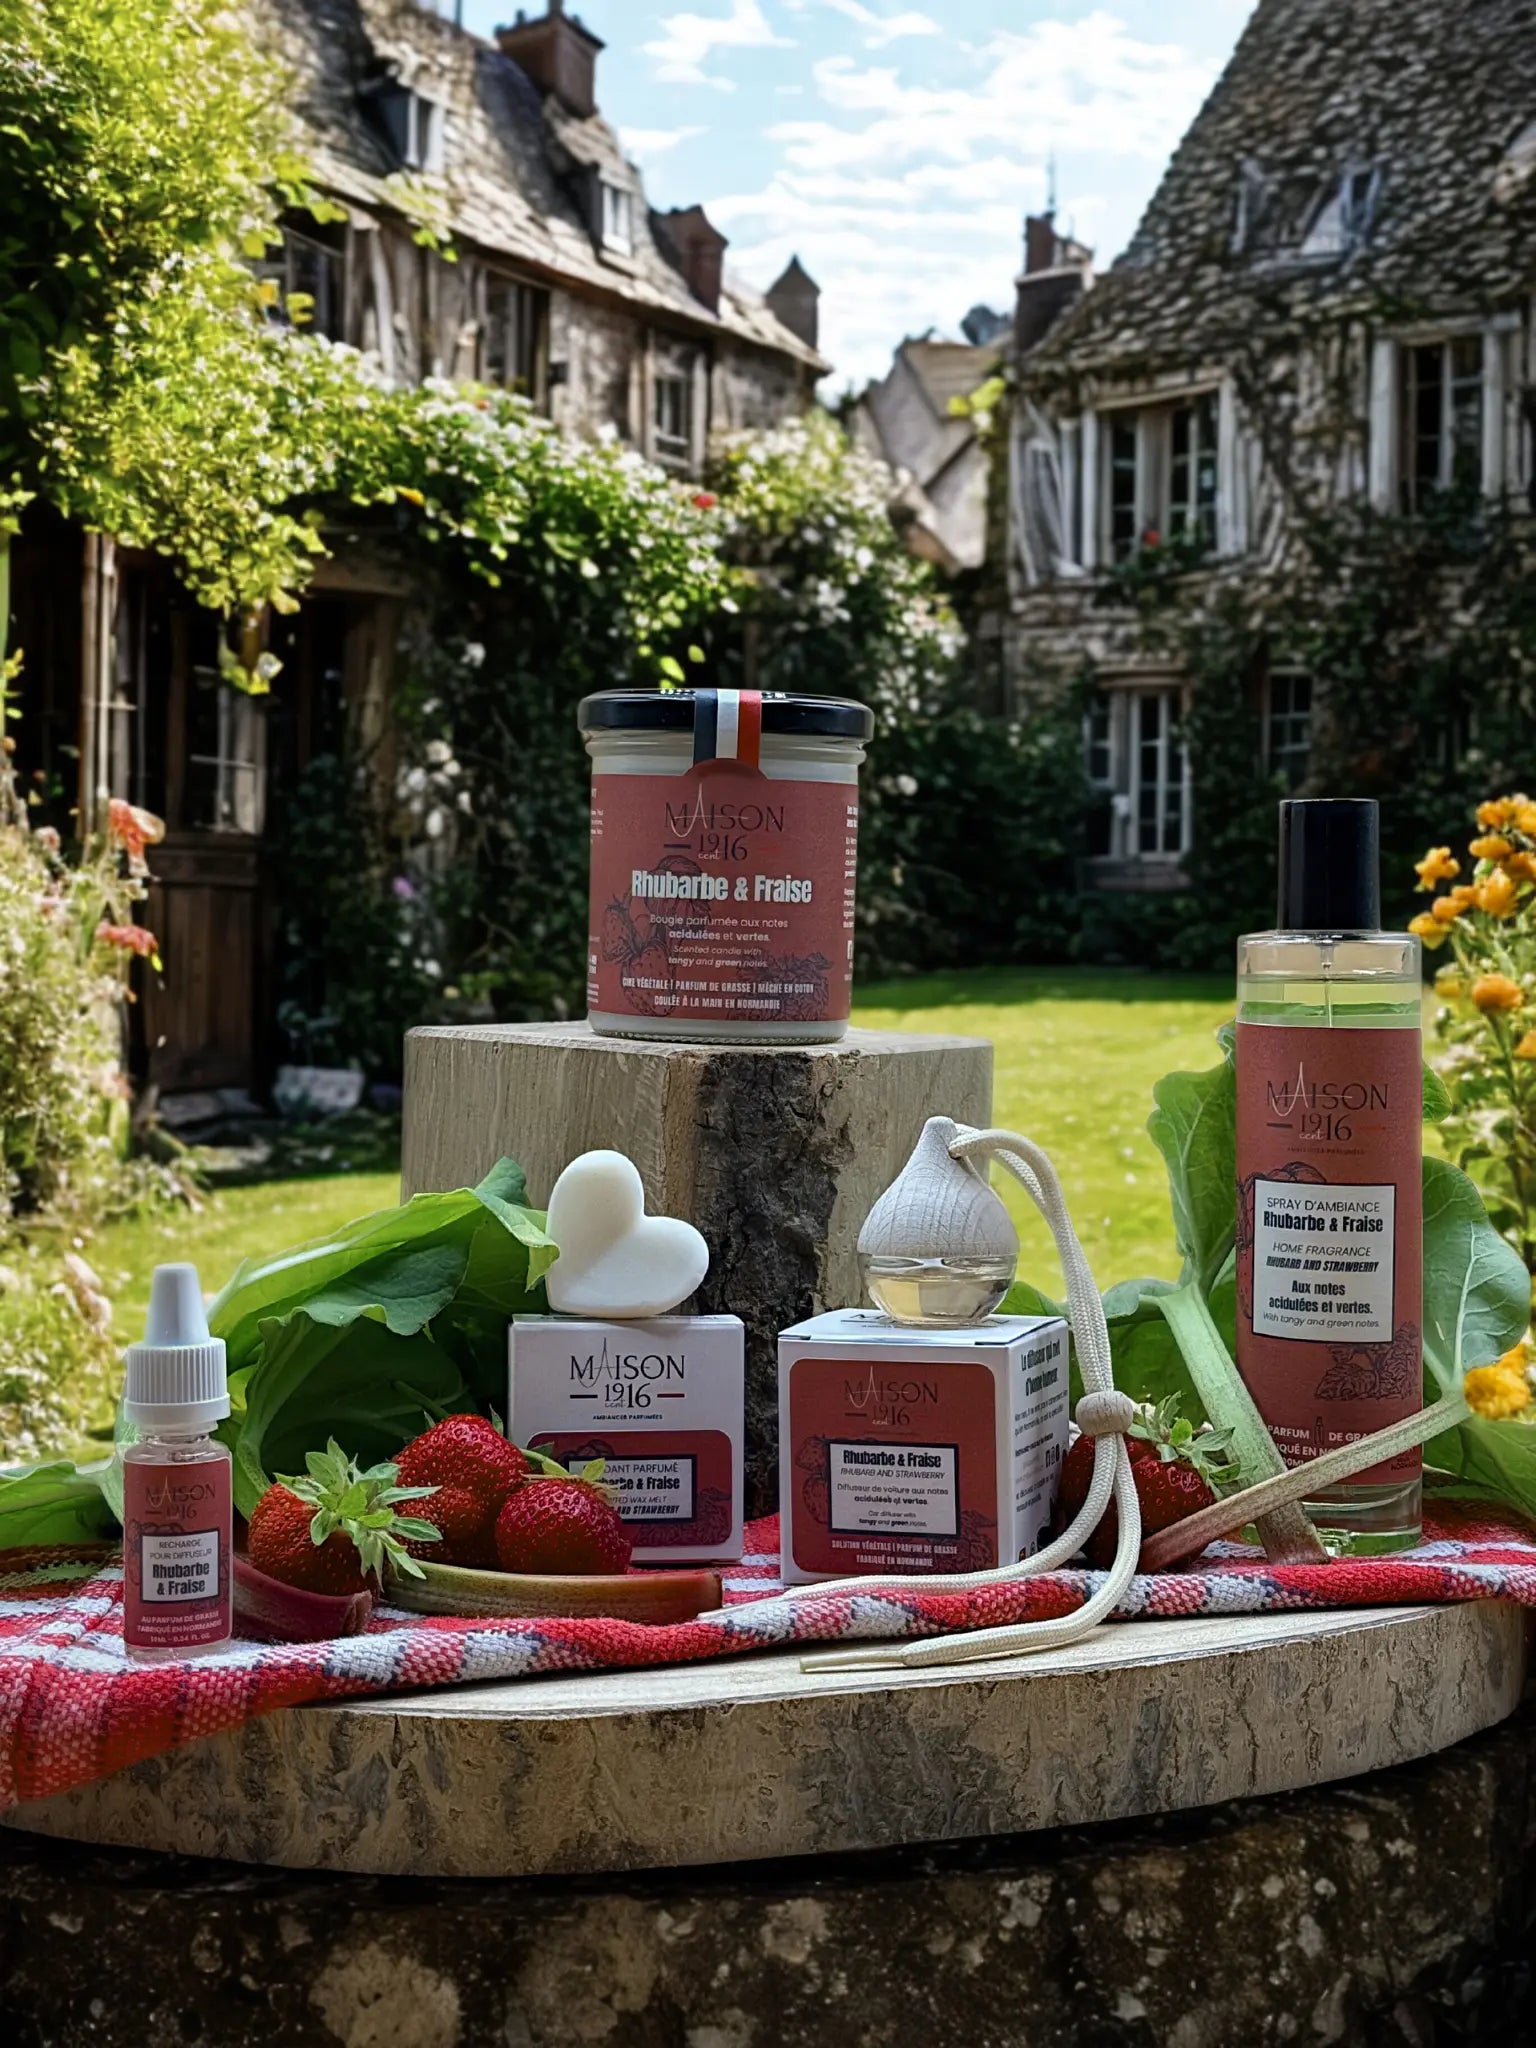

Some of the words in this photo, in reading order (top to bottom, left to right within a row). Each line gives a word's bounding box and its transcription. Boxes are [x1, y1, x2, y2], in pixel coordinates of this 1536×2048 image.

[664, 783, 784, 838] MAISON
[699, 833, 748, 861] 1916
[632, 870, 728, 901] Rhubarbe
[733, 877, 749, 901] &
[754, 874, 812, 904] Fraise
[650, 914, 684, 927] Bougie
[686, 916, 738, 927] parfumée
[740, 919, 759, 928] aux
[762, 919, 789, 928] notes
[669, 929, 720, 940] acidulées
[723, 932, 733, 941] et
[673, 946, 709, 954] Scented
[711, 946, 741, 955] candle
[744, 947, 762, 955] with
[668, 956, 695, 967] tangy
[695, 956, 714, 965] and
[715, 959, 741, 968] green
[622, 976, 637, 987] CIRE
[636, 977, 668, 990] VÉGÉTALE
[675, 980, 707, 992] PARFUM
[709, 981, 720, 992] DE
[721, 981, 751, 993] GRASSE
[784, 983, 793, 994] EN
[794, 983, 814, 994] COTON
[654, 993, 680, 1006] COULÉE
[682, 994, 688, 1007] À
[690, 996, 700, 1007] LA
[702, 997, 723, 1008] MAIN
[725, 998, 734, 1009] EN
[737, 998, 780, 1010] NORMANDIE
[1266, 1061, 1389, 1117] MAISON
[1299, 1128, 1324, 1141] cent
[1300, 1113, 1353, 1141] 1916
[1267, 1197, 1302, 1211] SPRAY
[1304, 1199, 1380, 1213] D'AMBIANCE
[1263, 1211, 1325, 1232] Rhubarbe
[1329, 1218, 1338, 1232] &
[1342, 1216, 1383, 1233] Fraise
[1272, 1242, 1303, 1254] HOME
[1305, 1245, 1371, 1257] FRAGRANCE
[1266, 1255, 1301, 1270] RHUBARB
[1303, 1259, 1321, 1271] AND
[1323, 1260, 1379, 1273] STRAWBERRY
[1291, 1280, 1311, 1294] Aux
[1314, 1282, 1346, 1296] notes
[1269, 1296, 1318, 1313] acidulées
[1321, 1300, 1333, 1313] et
[1336, 1300, 1373, 1314] vertes.
[1280, 1314, 1305, 1326] tangy
[1306, 1316, 1325, 1326] and
[1326, 1318, 1354, 1328] green
[569, 1337, 685, 1389] MAISON
[843, 1365, 938, 1408] MAISON
[604, 1382, 651, 1408] 1916
[628, 1413, 663, 1421] PARFUMÉES
[872, 1403, 910, 1426] 1916
[1267, 1424, 1310, 1440] PARFUM
[1328, 1432, 1343, 1442] DE
[843, 1450, 895, 1466] Rhubarbe
[897, 1453, 904, 1466] &
[907, 1452, 941, 1468] Fraise
[1302, 1446, 1317, 1456] EN
[633, 1462, 678, 1473] PARFUMÉ
[840, 1467, 875, 1477] RHUBARB
[877, 1469, 895, 1478] AND
[895, 1470, 946, 1480] STRAWBERRY
[145, 1474, 216, 1508] MAISON
[636, 1479, 644, 1490] &
[646, 1476, 680, 1490] Fraise
[871, 1484, 882, 1493] de
[926, 1487, 949, 1495] notes
[165, 1504, 197, 1520] 1916
[633, 1505, 680, 1515] STRAWBERRY
[159, 1539, 201, 1549] RECHARGE
[896, 1543, 923, 1553] PARFUM
[923, 1544, 932, 1554] DE
[933, 1545, 958, 1554] GRASSE
[149, 1551, 171, 1560] POUR
[173, 1547, 213, 1560] DIFFUSEUR
[856, 1554, 886, 1565] FABRIQUÉ
[152, 1562, 210, 1579] Rhubarbe
[157, 1582, 165, 1596] &
[168, 1579, 206, 1596] Fraise
[141, 1616, 151, 1624] AU
[151, 1616, 183, 1624] PARFUM
[172, 1625, 182, 1633] EN
